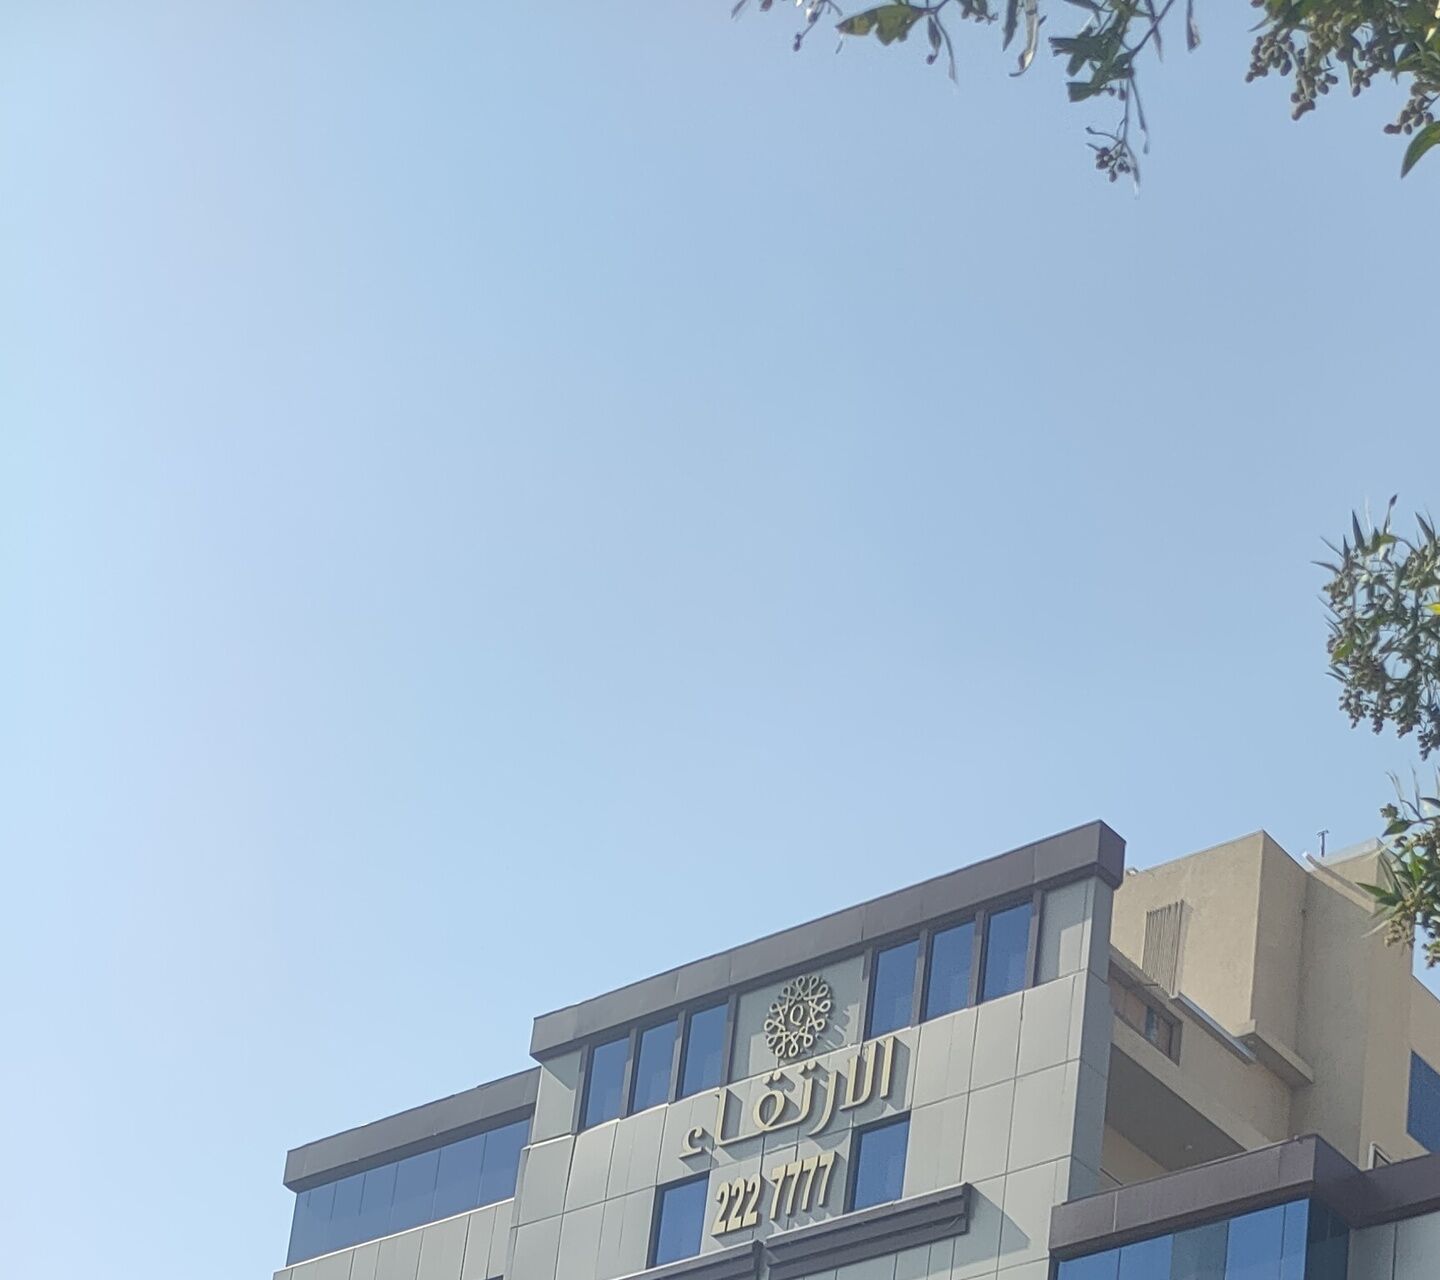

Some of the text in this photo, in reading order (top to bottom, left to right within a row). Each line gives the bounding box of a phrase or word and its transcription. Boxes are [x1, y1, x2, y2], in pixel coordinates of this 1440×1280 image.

[679, 1036, 894, 1158] الارتقاء
[711, 1150, 836, 1235] 222 7777
